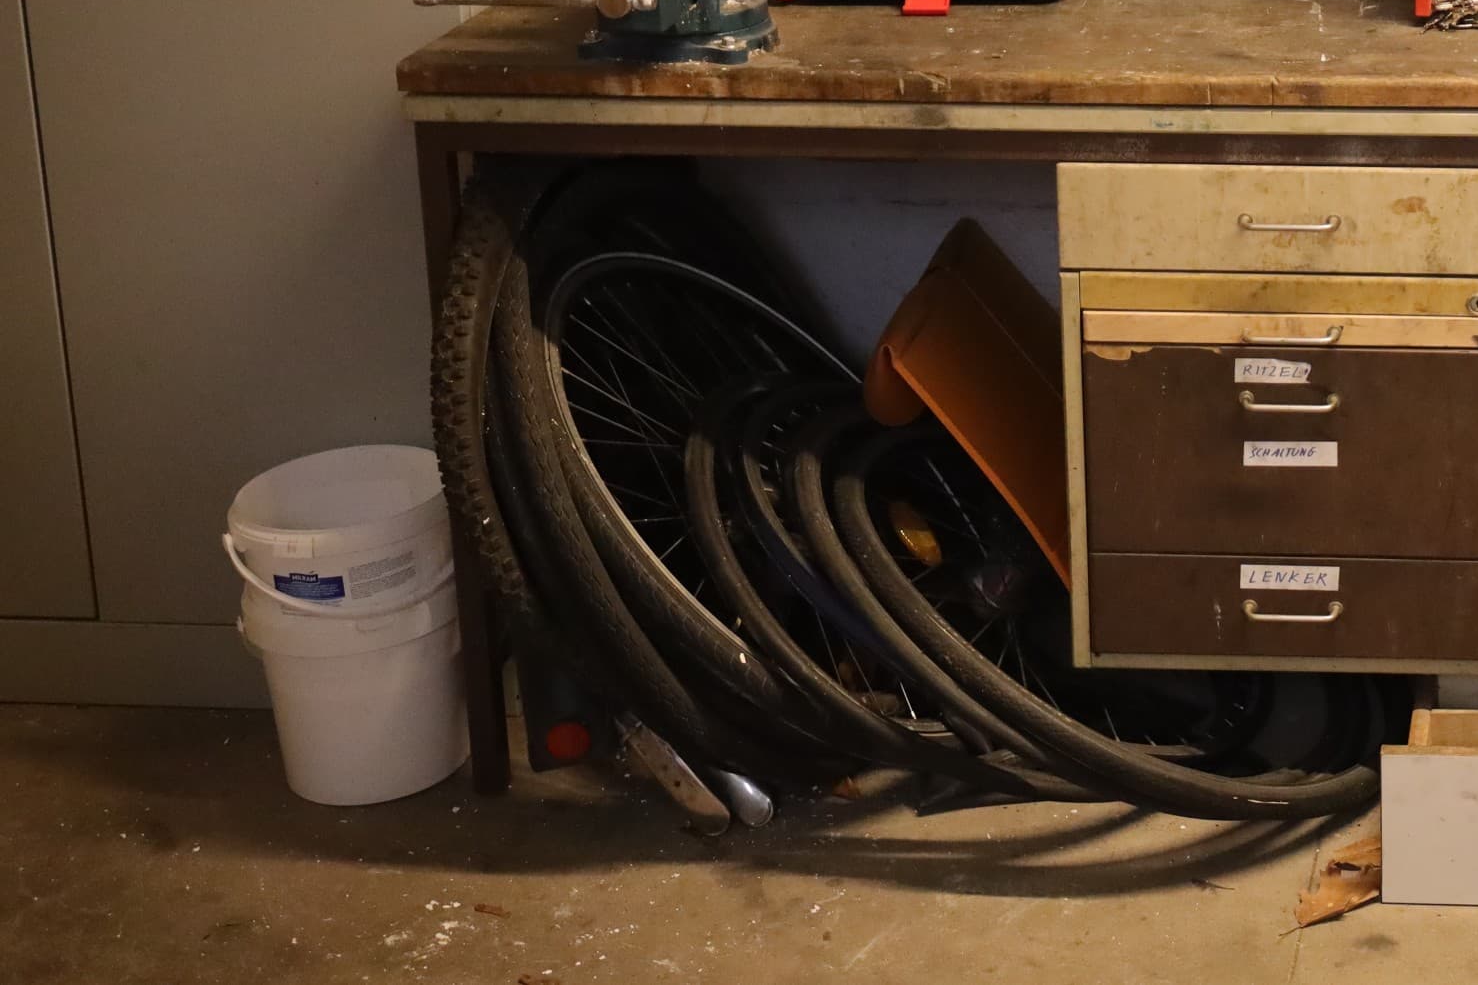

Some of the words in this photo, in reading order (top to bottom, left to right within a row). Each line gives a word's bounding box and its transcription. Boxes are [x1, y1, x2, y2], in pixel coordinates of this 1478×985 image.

[1242, 364, 1303, 378] RITZEL
[1248, 445, 1317, 459] SCHALTUNG
[1248, 570, 1328, 587] LENKER
